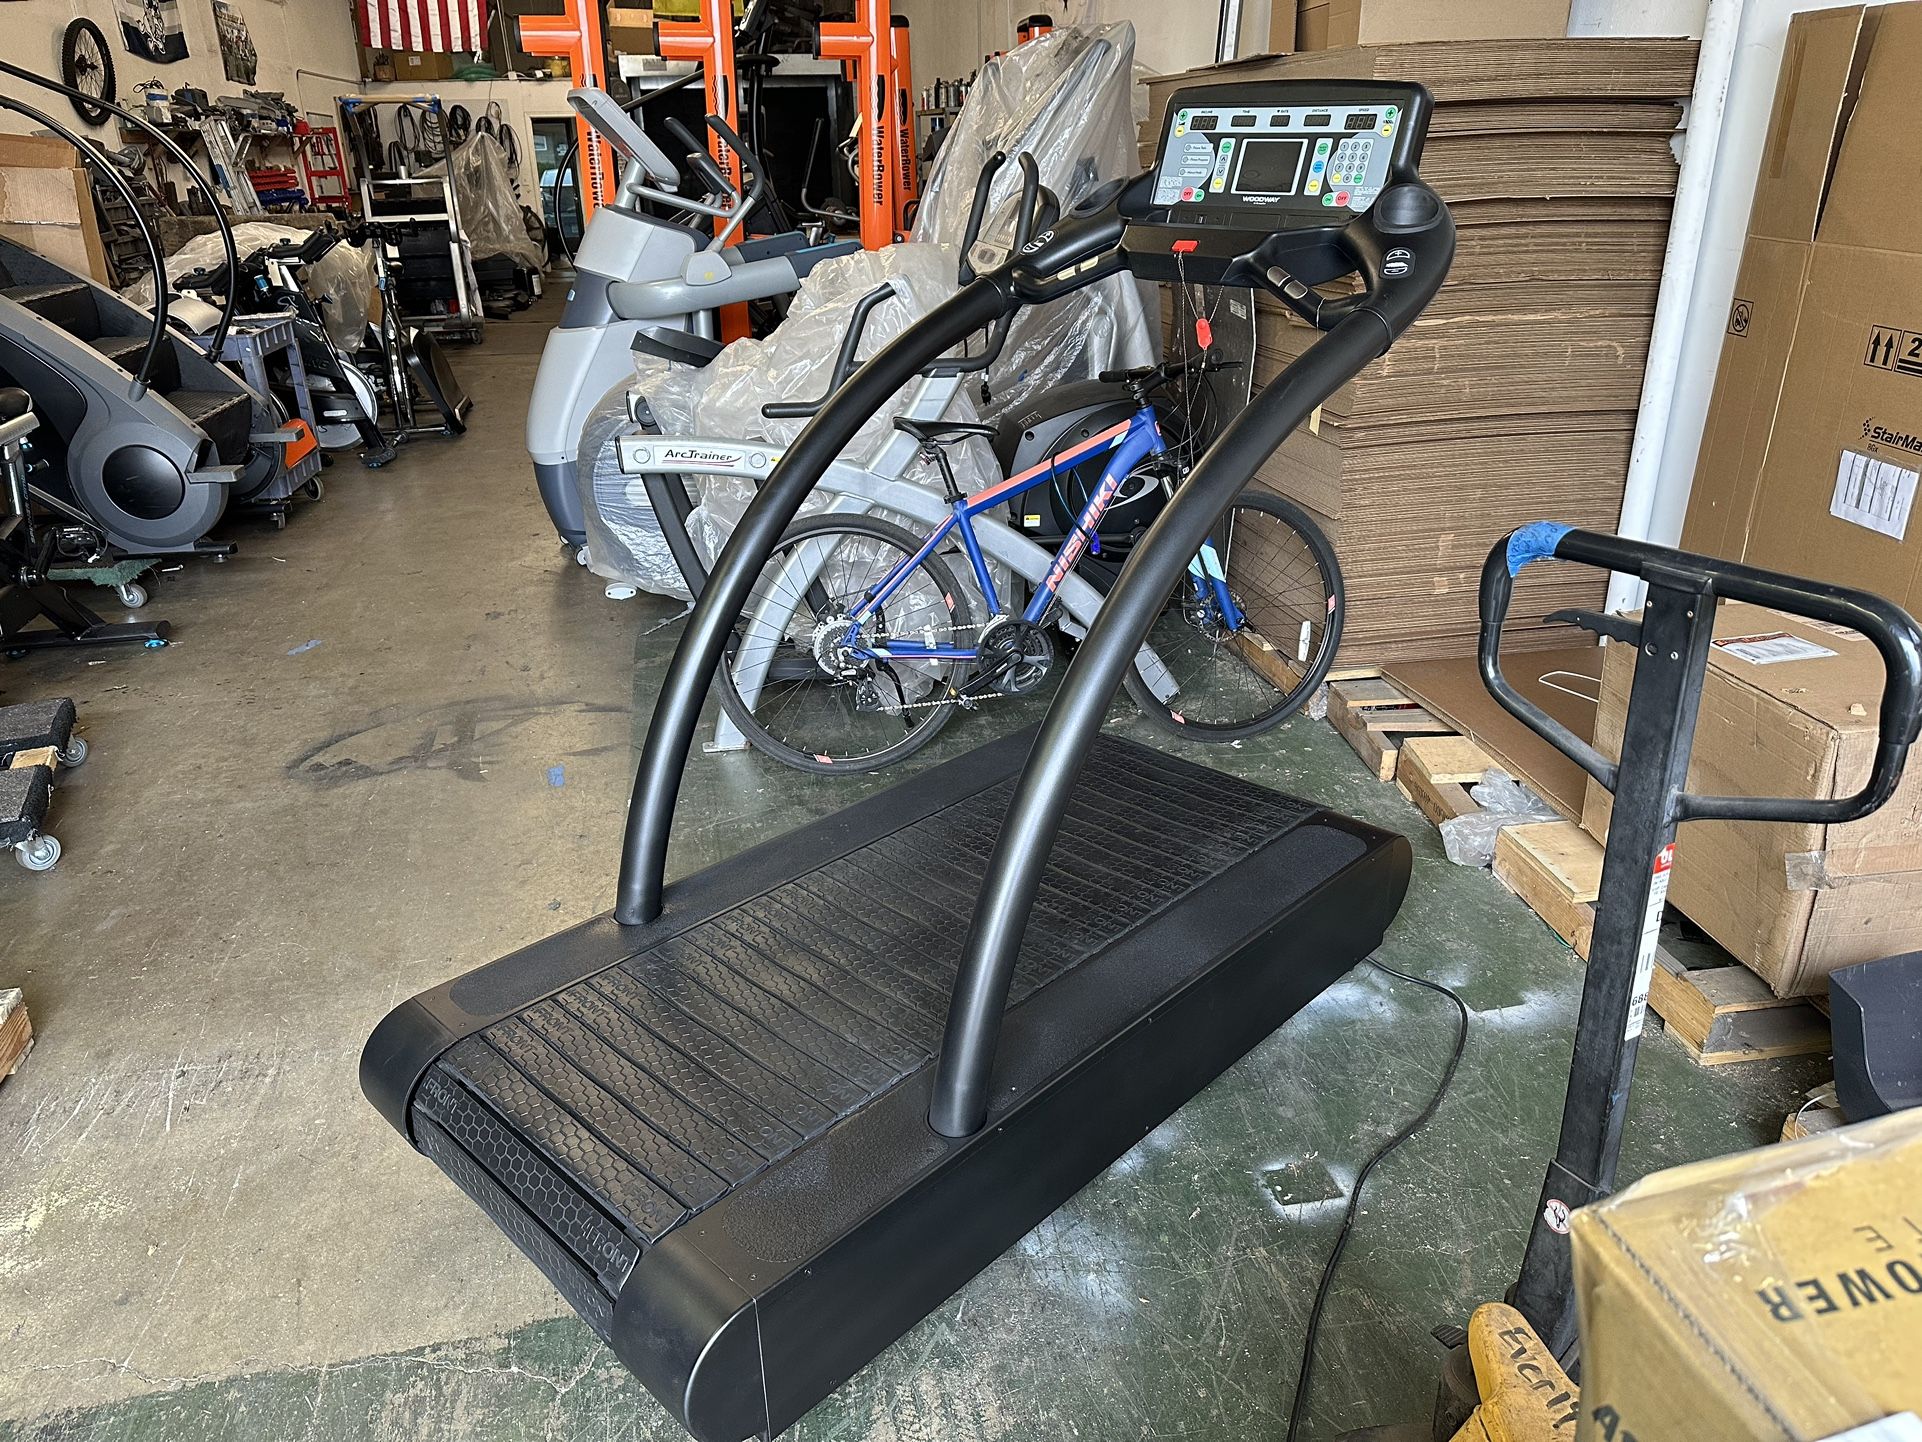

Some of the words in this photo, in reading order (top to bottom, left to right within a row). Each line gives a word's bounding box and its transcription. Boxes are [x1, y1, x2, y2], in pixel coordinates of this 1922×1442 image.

[872, 126, 886, 206] WaterRower
[899, 128, 912, 192] WaterRower
[664, 449, 733, 461] ArcTrainer
[1870, 426, 1922, 452] StairMa
[1046, 473, 1118, 592] NISHIKI
